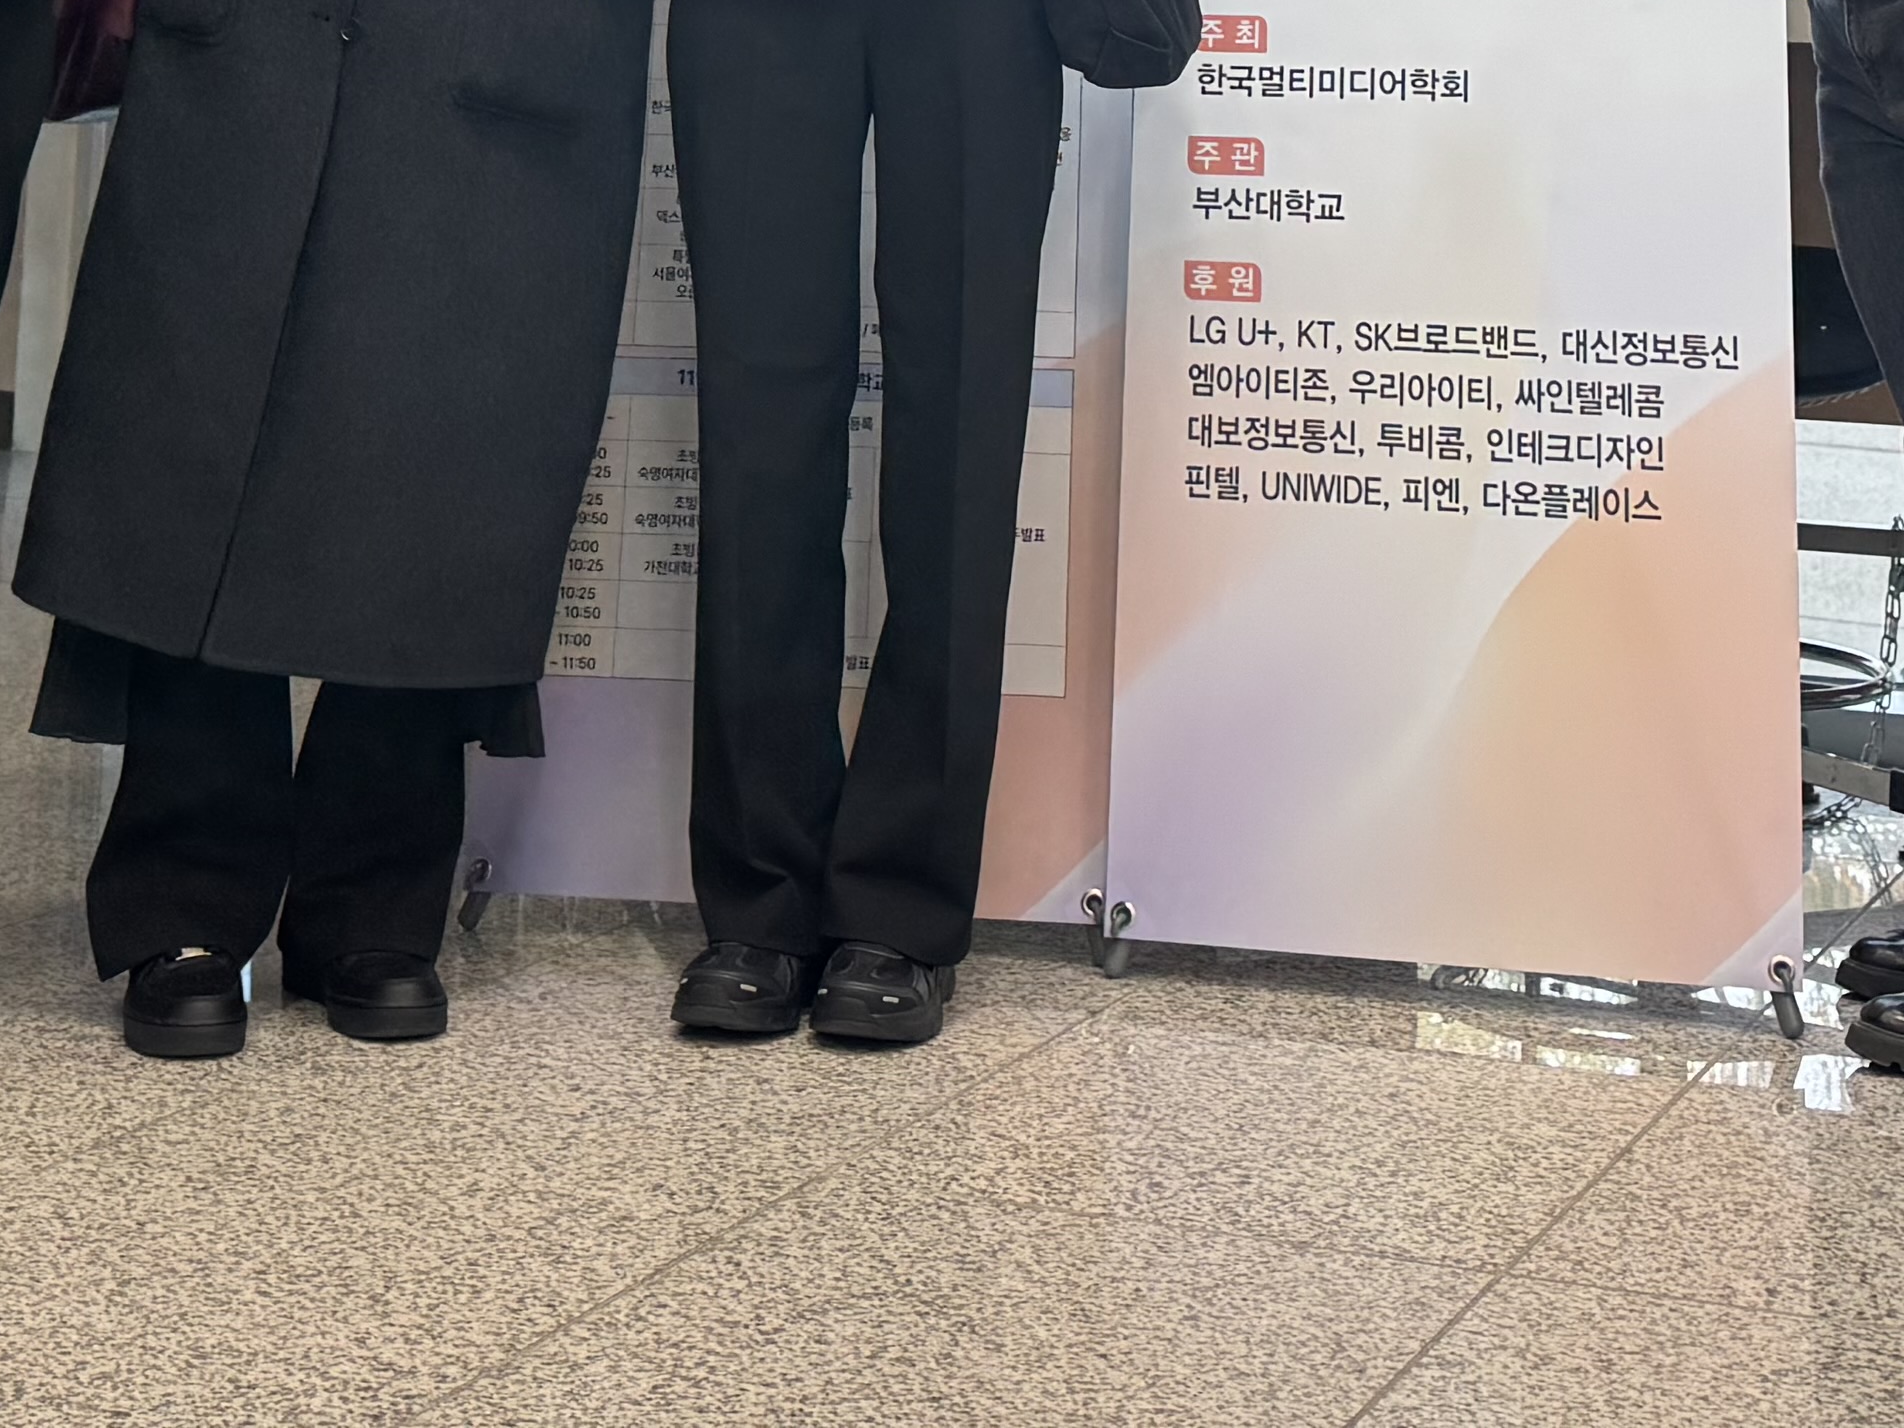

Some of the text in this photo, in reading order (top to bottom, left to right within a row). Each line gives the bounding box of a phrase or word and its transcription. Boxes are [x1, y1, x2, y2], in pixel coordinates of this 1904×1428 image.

[1197, 64, 1470, 104] 한국멀티미디어학회
[1192, 188, 1345, 223] 부산대학교
[1188, 315, 1740, 371] LG U+, KT, SK브로드밴드, 대신정보통신
[1187, 362, 1665, 419] 엠아이티존, 우리아이티, 싸인텔레콤
[1187, 413, 1665, 473] 대보정보통신, 투비콤, 인테크디자인
[1185, 464, 1663, 523] 핀텔, UNIWIDE, 피엔, 다온플레이스
[569, 559, 604, 572] 10:25
[560, 587, 596, 600] 10:25
[558, 634, 592, 647] 11:00
